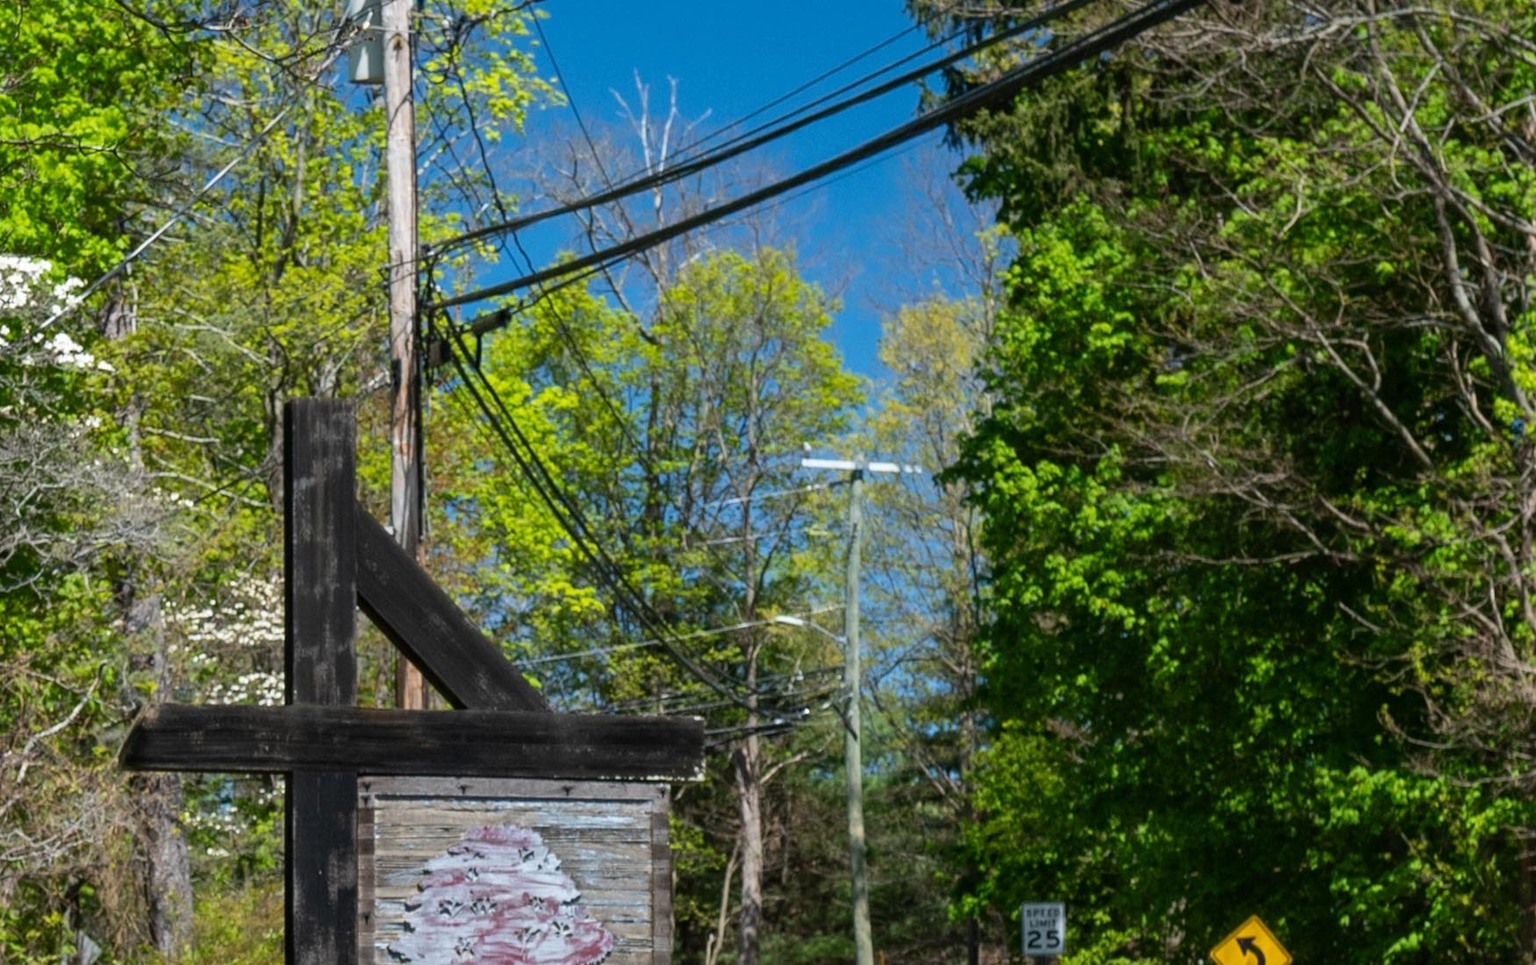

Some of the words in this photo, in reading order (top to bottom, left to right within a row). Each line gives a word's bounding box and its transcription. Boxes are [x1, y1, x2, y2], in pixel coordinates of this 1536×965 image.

[1026, 908, 1061, 919] SPEED
[1029, 920, 1057, 929] LIMIT
[1027, 930, 1060, 949] 25
